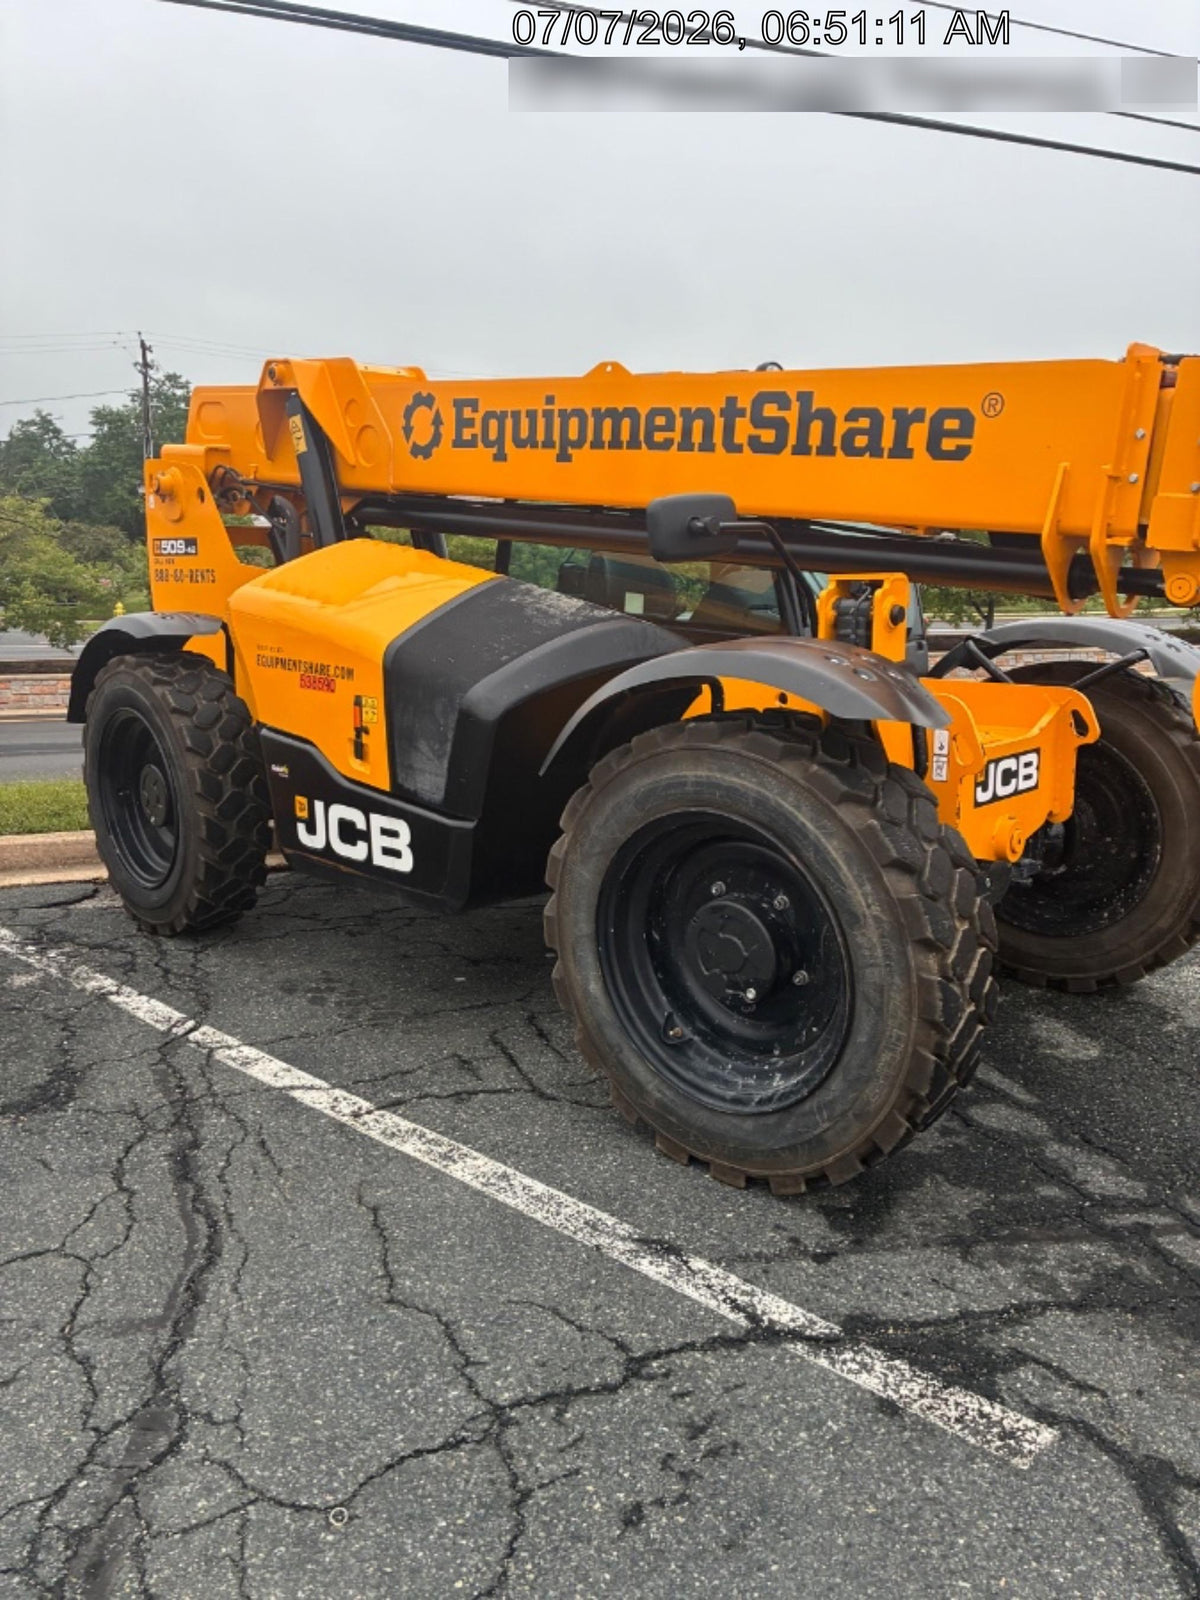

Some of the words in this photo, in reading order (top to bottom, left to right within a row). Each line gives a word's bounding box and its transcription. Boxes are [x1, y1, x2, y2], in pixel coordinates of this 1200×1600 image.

[452, 391, 976, 462] EquipmentShare
[256, 654, 354, 681] EQUIPMENTSHARE.COM
[976, 752, 1039, 802] JCB
[296, 799, 414, 873] JCB
